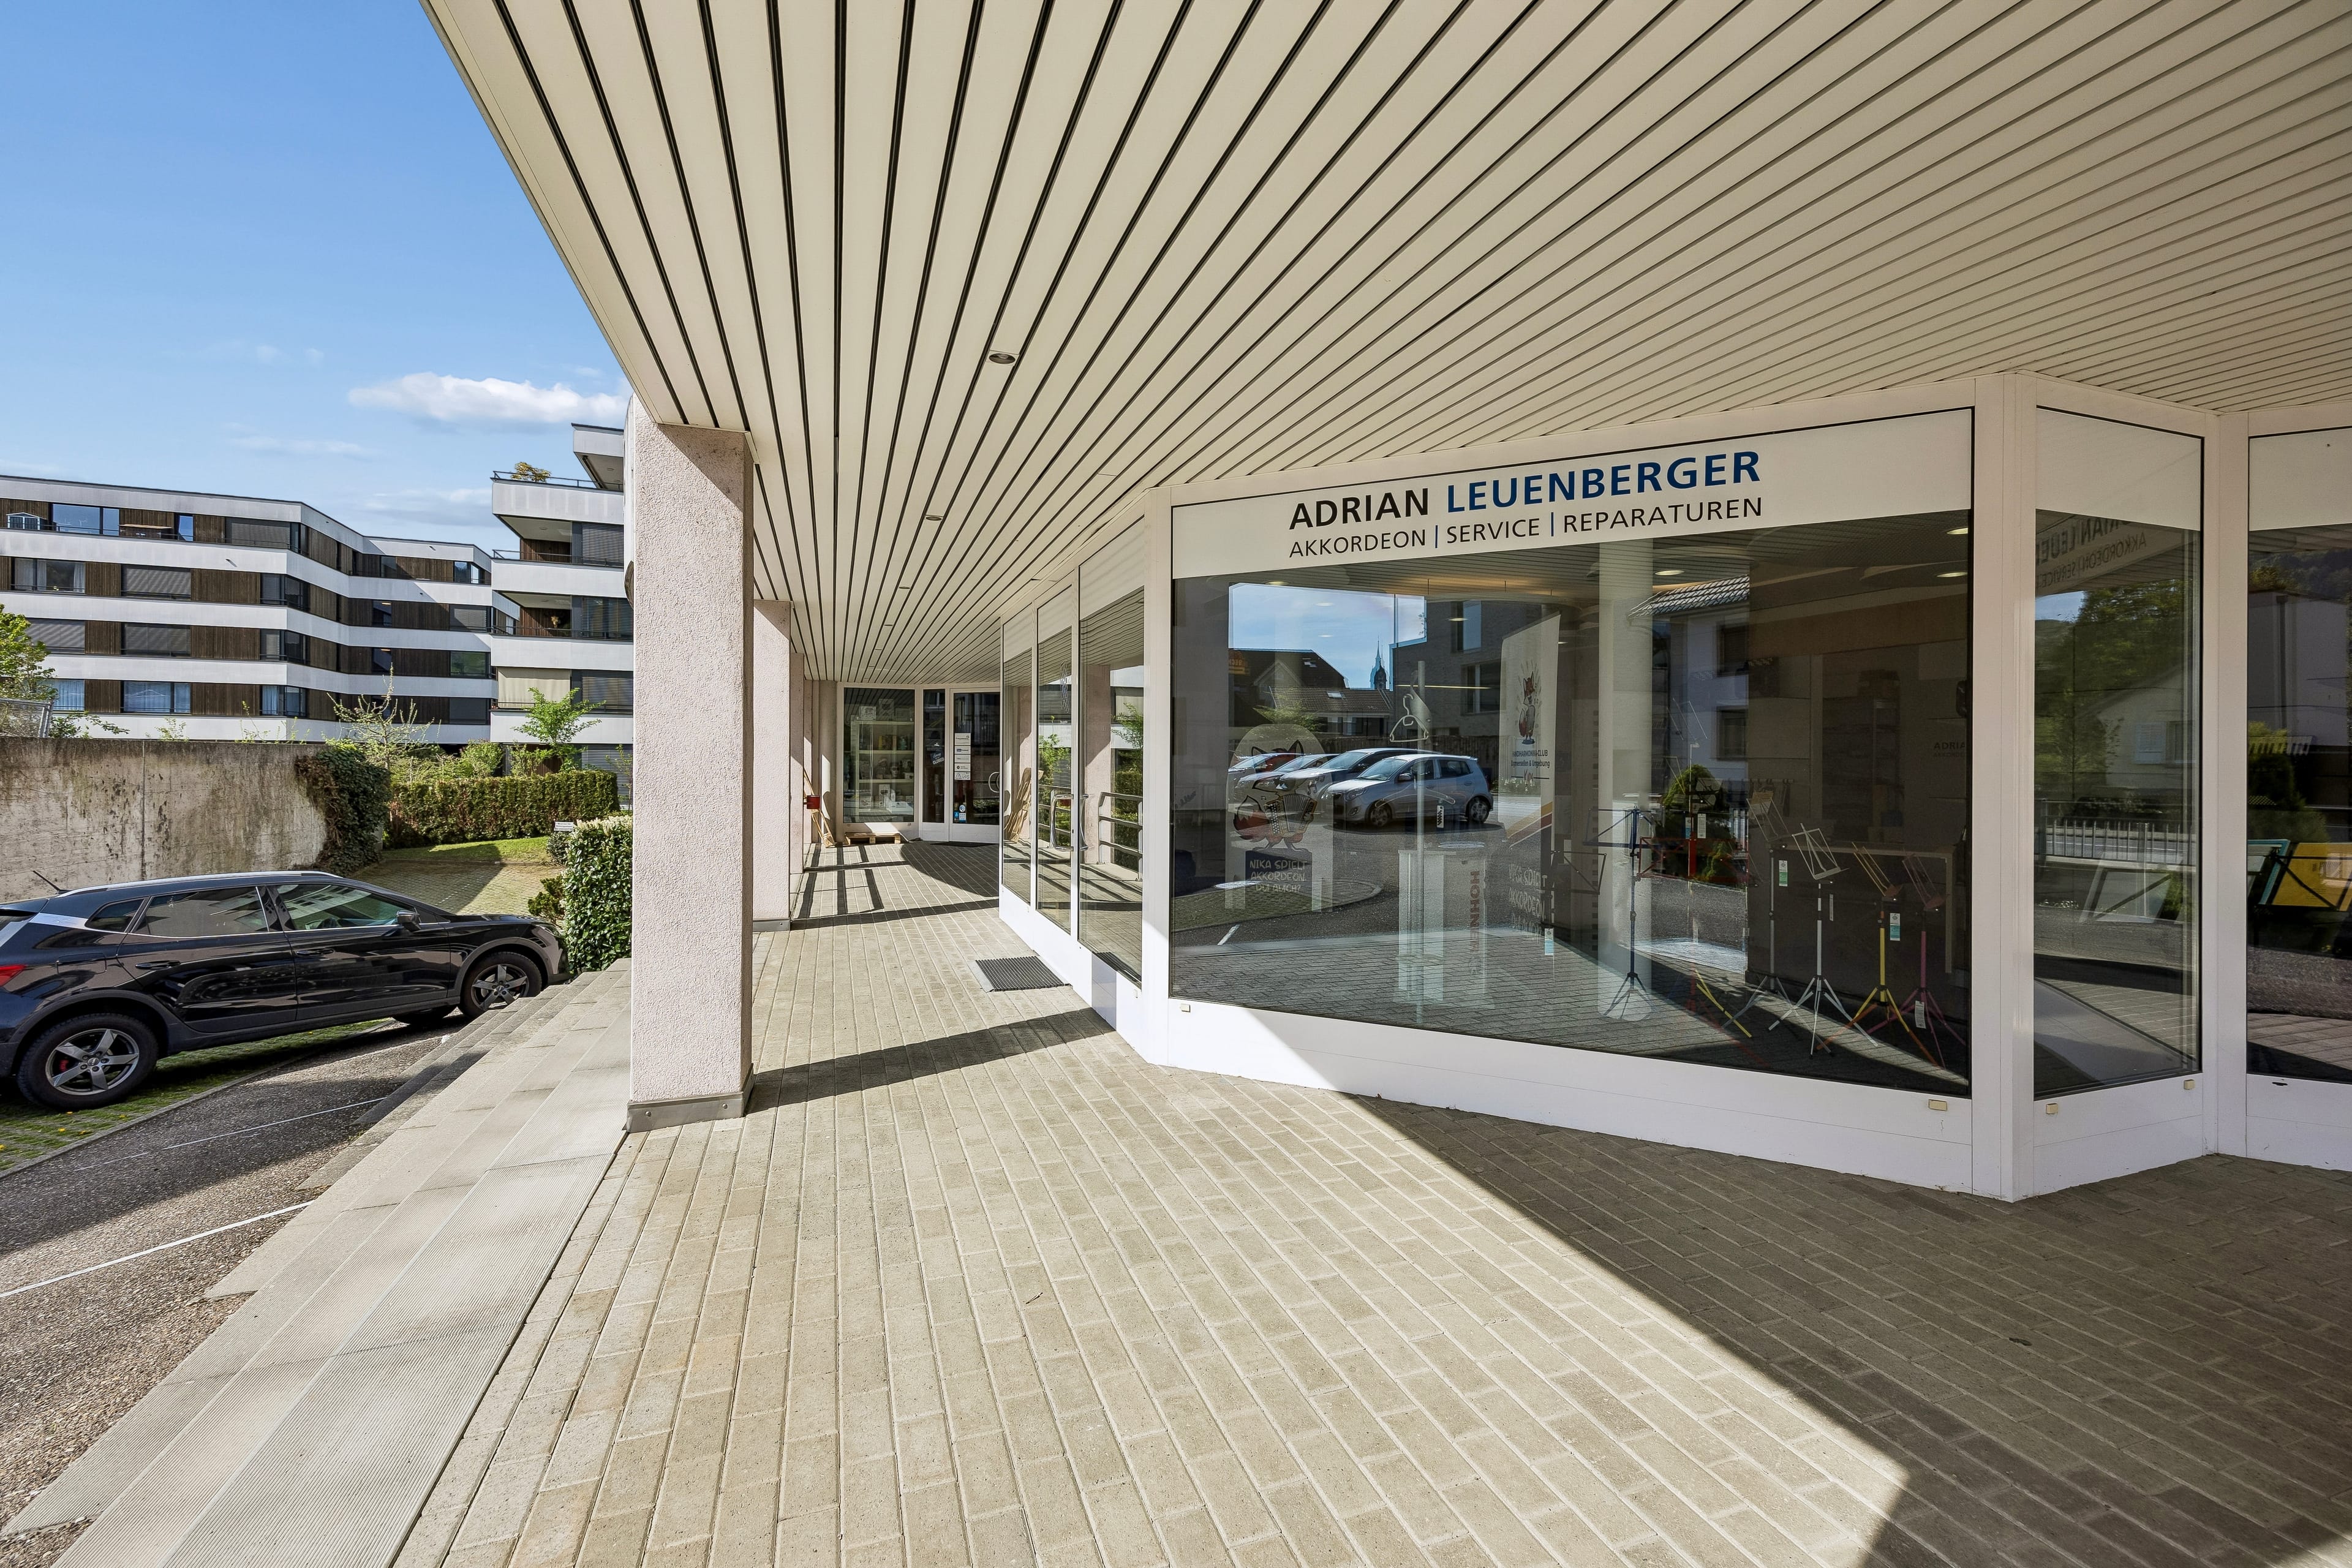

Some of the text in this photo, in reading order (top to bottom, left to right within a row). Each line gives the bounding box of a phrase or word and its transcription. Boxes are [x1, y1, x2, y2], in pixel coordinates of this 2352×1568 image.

[1289, 451, 1761, 530] ADRIAN LEUENBERGER
[1289, 497, 1762, 558] AKKORDEON SERVICE REPARATUREN
[1250, 860, 1308, 870] NIKA SPIELT
